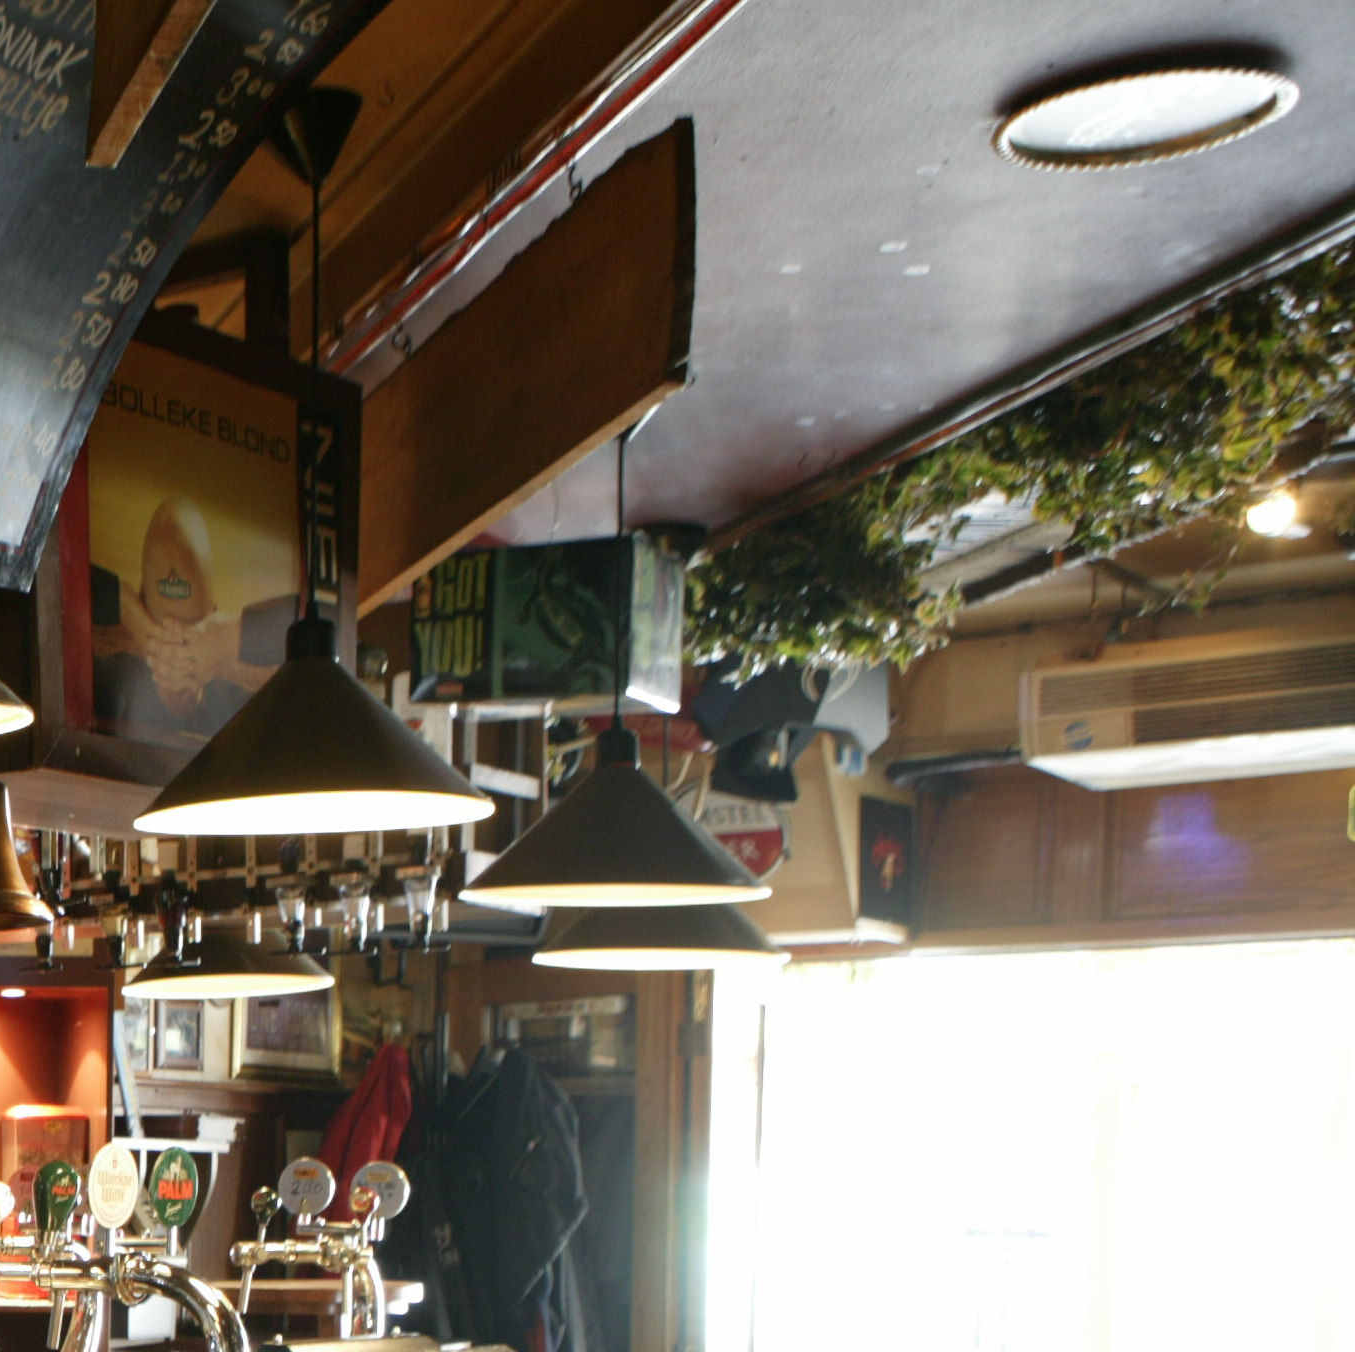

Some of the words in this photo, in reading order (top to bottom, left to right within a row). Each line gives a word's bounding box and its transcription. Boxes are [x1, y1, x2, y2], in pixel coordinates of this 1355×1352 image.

[216, 416, 290, 464] BLOND
[52, 1185, 77, 1196] PALM
[158, 1179, 193, 1200] PALM
